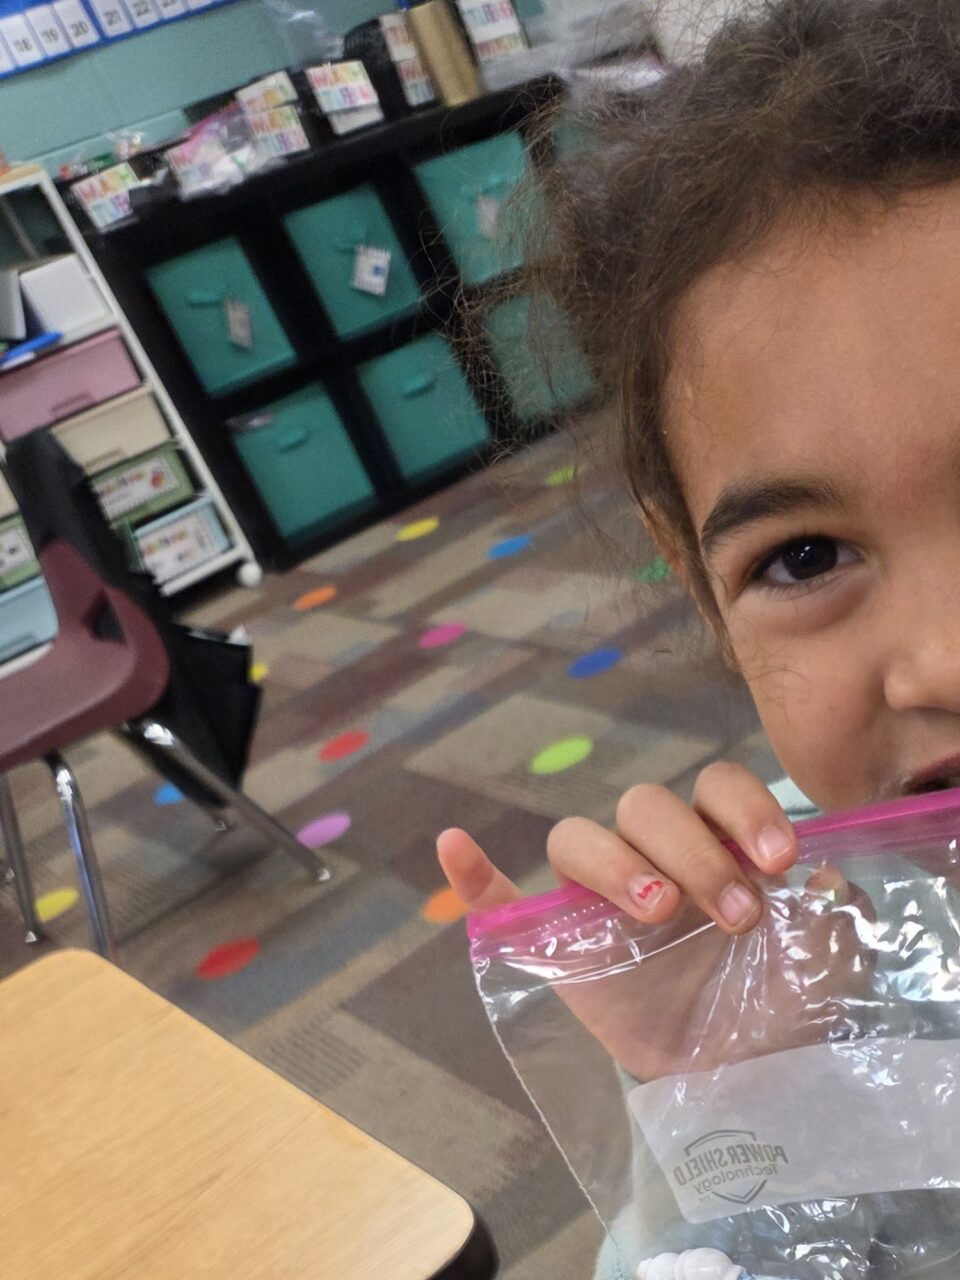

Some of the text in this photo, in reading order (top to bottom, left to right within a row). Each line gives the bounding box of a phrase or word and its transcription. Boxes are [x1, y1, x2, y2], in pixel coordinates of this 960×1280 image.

[41, 28, 59, 44] 19
[68, 20, 90, 39] 20
[102, 9, 120, 26] 21
